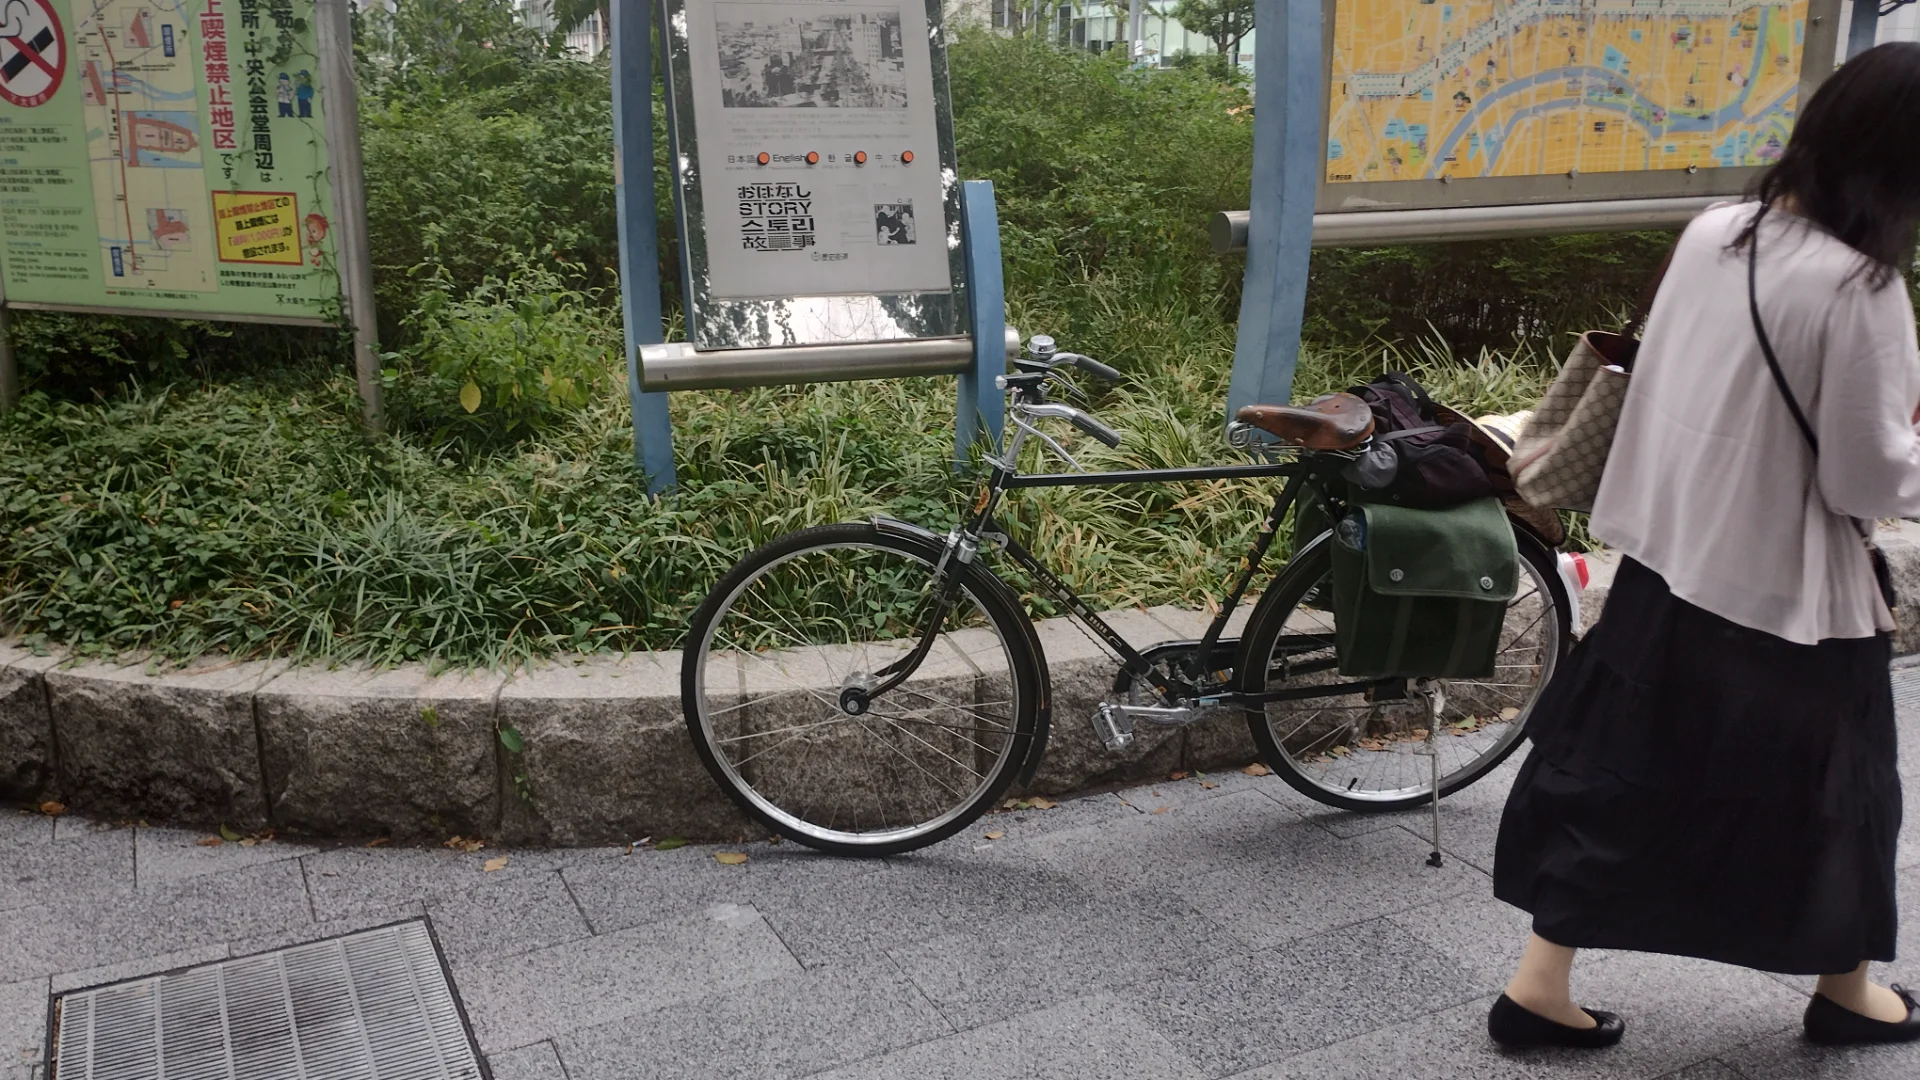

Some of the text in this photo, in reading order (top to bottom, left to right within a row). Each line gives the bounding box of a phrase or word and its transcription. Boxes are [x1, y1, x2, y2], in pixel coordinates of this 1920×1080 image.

[727, 154, 757, 164] 日本語
[772, 153, 808, 163] English
[737, 185, 811, 199] おはなし
[739, 201, 812, 216] STORY
[741, 218, 815, 232] 스토리
